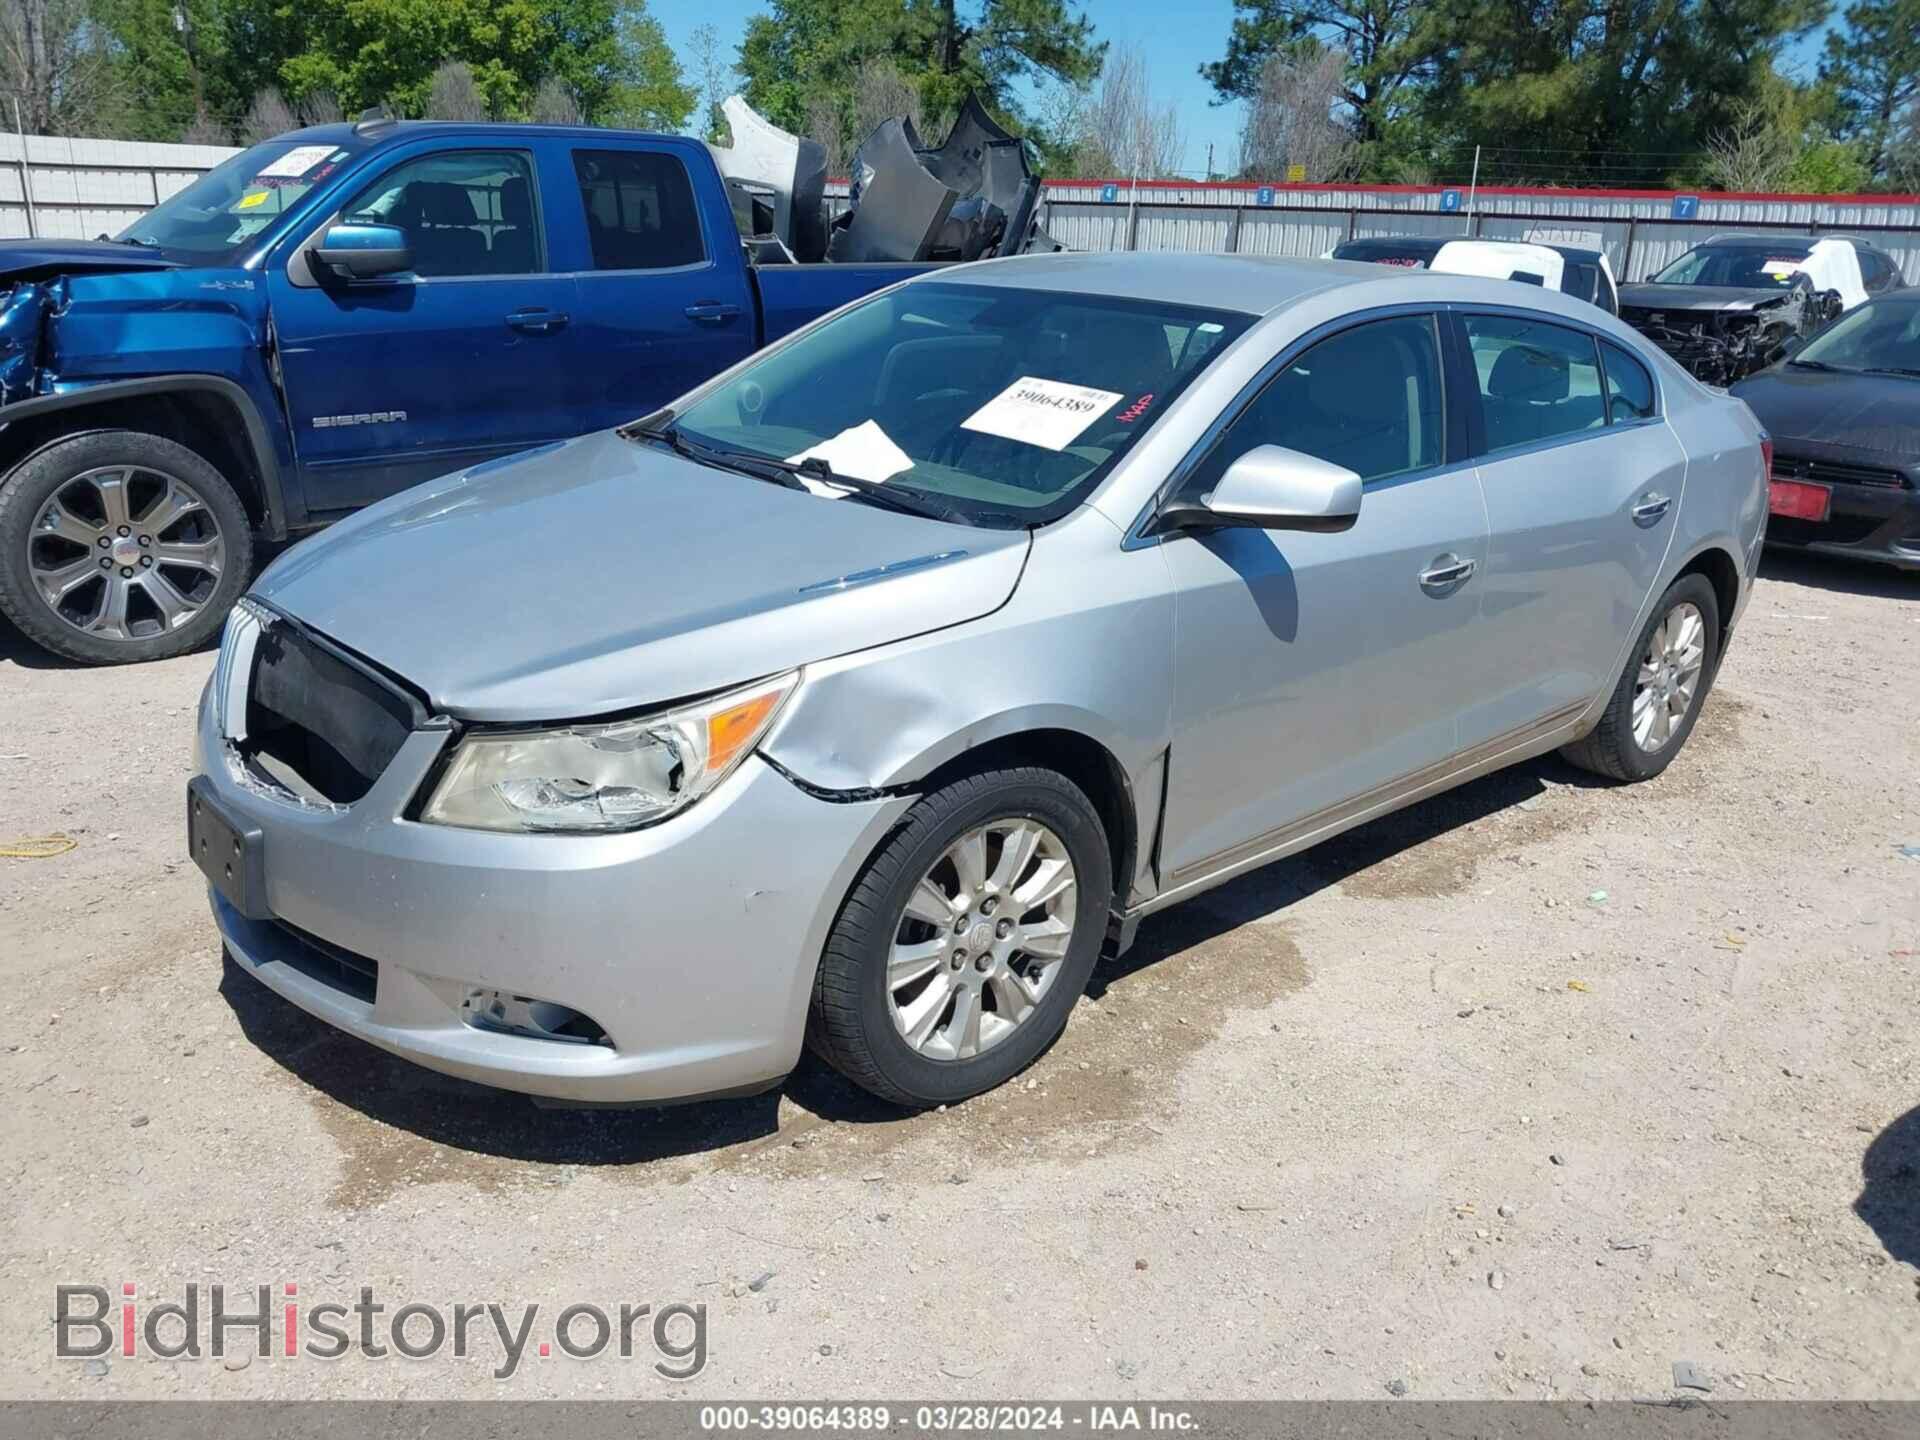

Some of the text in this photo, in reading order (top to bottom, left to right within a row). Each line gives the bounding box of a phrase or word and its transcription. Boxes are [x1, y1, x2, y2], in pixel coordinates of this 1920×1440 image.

[1446, 193, 1454, 207] 6
[1680, 200, 1691, 216] 7
[312, 410, 408, 429] SIERRA
